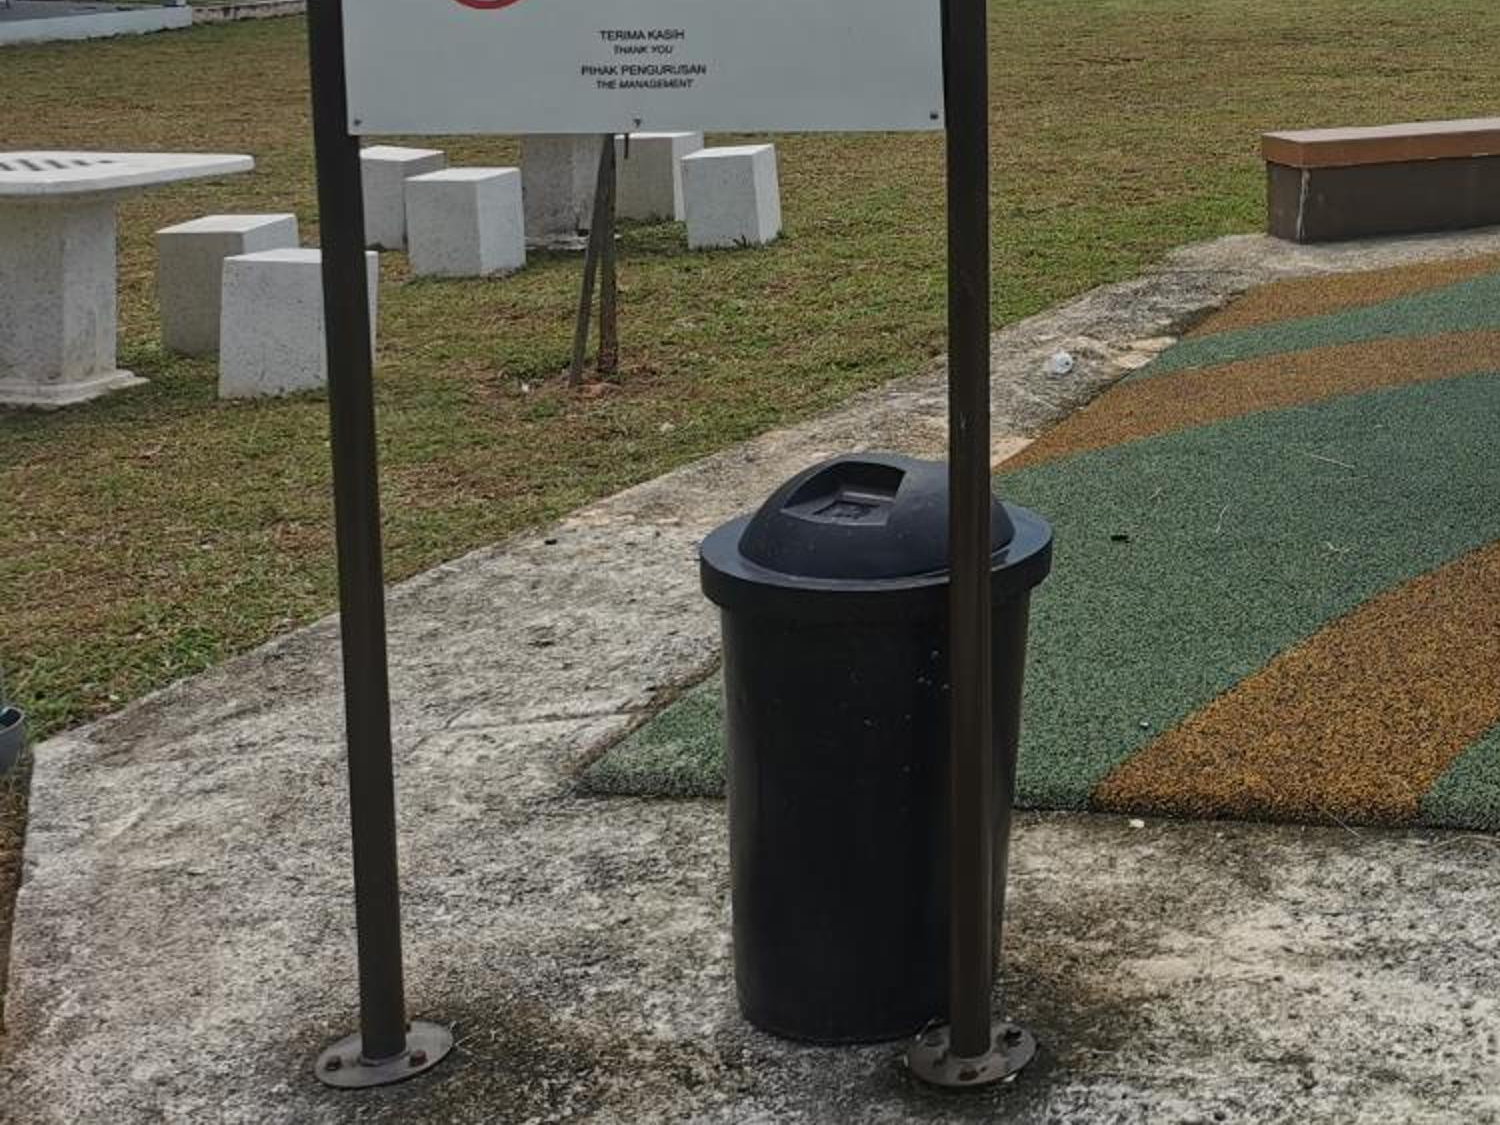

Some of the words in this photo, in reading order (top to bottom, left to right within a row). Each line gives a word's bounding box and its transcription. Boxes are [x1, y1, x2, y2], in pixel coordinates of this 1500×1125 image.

[600, 30, 646, 41] TERIMA
[648, 29, 684, 40] KASIH
[614, 45, 648, 54] THANK
[651, 45, 673, 54] YOU
[581, 65, 618, 75] PIHAK
[621, 64, 706, 75] PENGURUSAN
[597, 80, 616, 89] THE
[619, 79, 693, 88] MANAGEMENT
